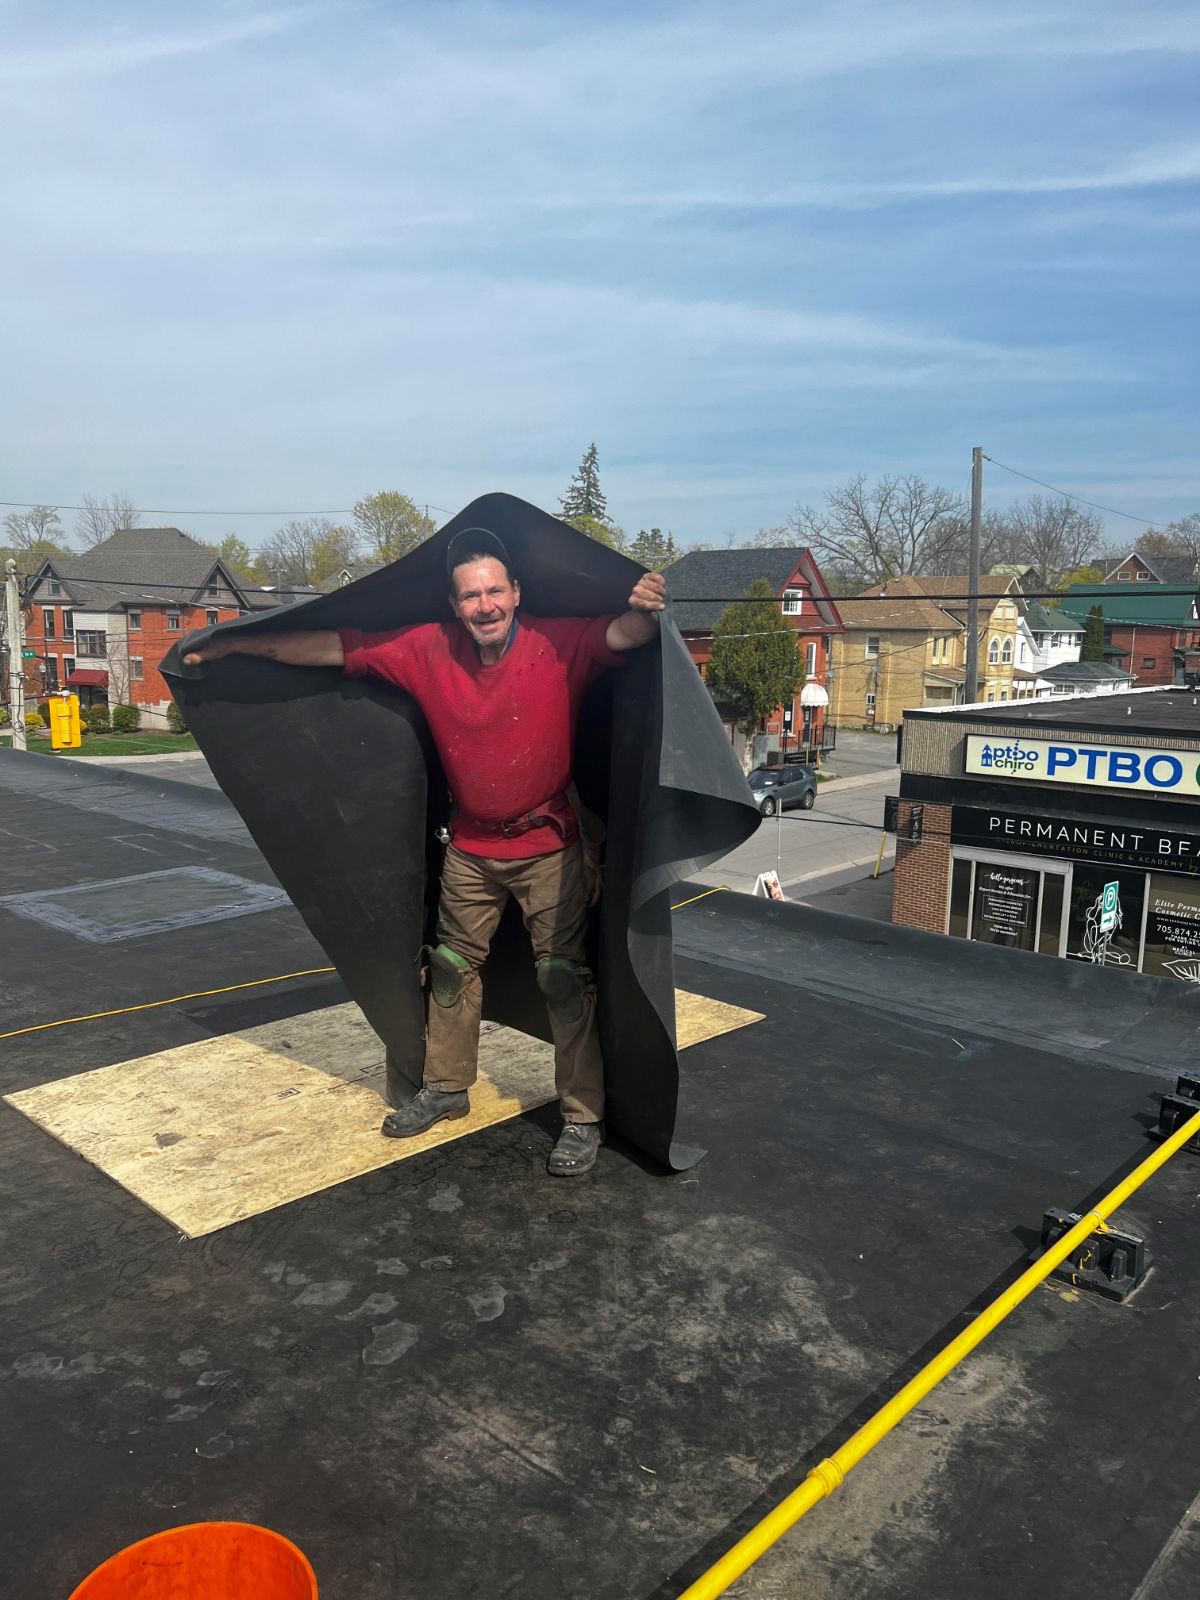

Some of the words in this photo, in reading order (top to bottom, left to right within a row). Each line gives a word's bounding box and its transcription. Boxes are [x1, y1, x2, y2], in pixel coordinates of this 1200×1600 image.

[995, 758, 1034, 771] chiro
[1046, 746, 1183, 788] PTBO
[989, 817, 1144, 850] PERMANENT
[1093, 850, 1125, 860] CLINIC
[1138, 856, 1184, 868] ACADEMY
[1154, 899, 1175, 908] Elite
[1155, 906, 1191, 918] Cosmetic
[1156, 924, 1200, 939] 705.874.2
